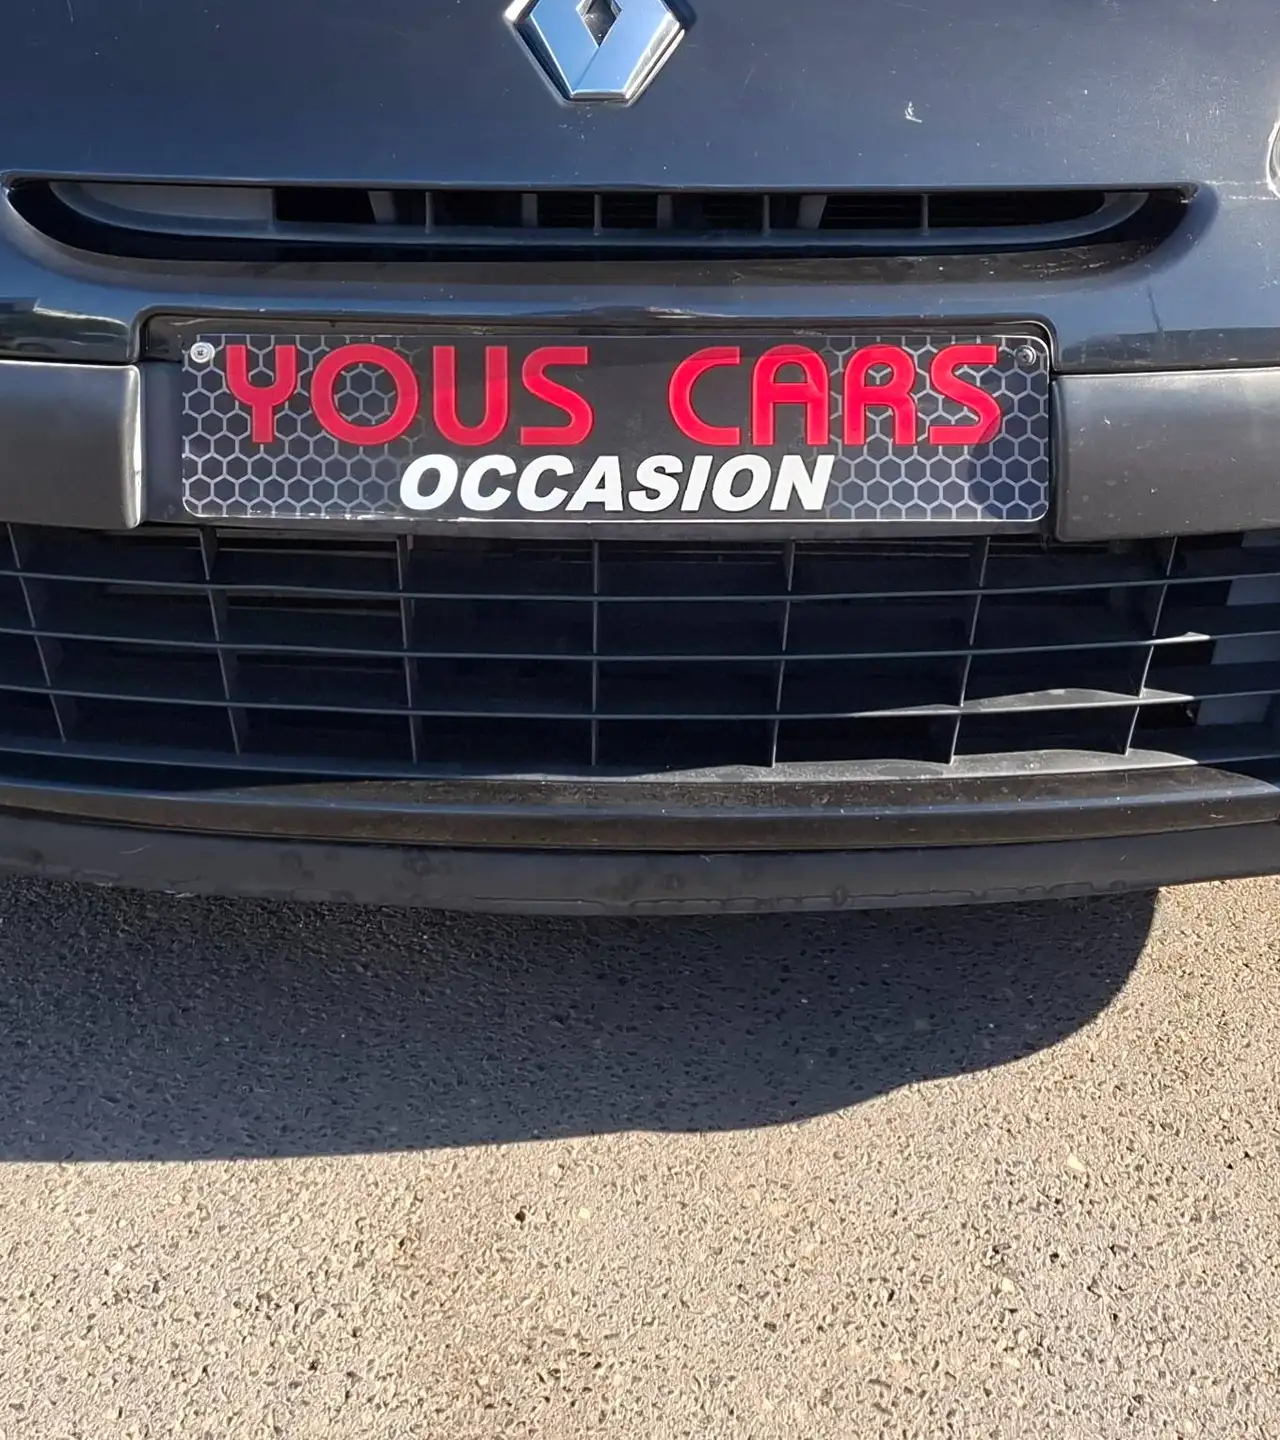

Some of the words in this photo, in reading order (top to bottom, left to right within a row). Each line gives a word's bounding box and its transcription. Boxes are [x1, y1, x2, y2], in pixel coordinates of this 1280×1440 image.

[224, 343, 594, 446] YOUS
[667, 343, 1000, 447] CARS
[399, 453, 836, 513] OCCASION
